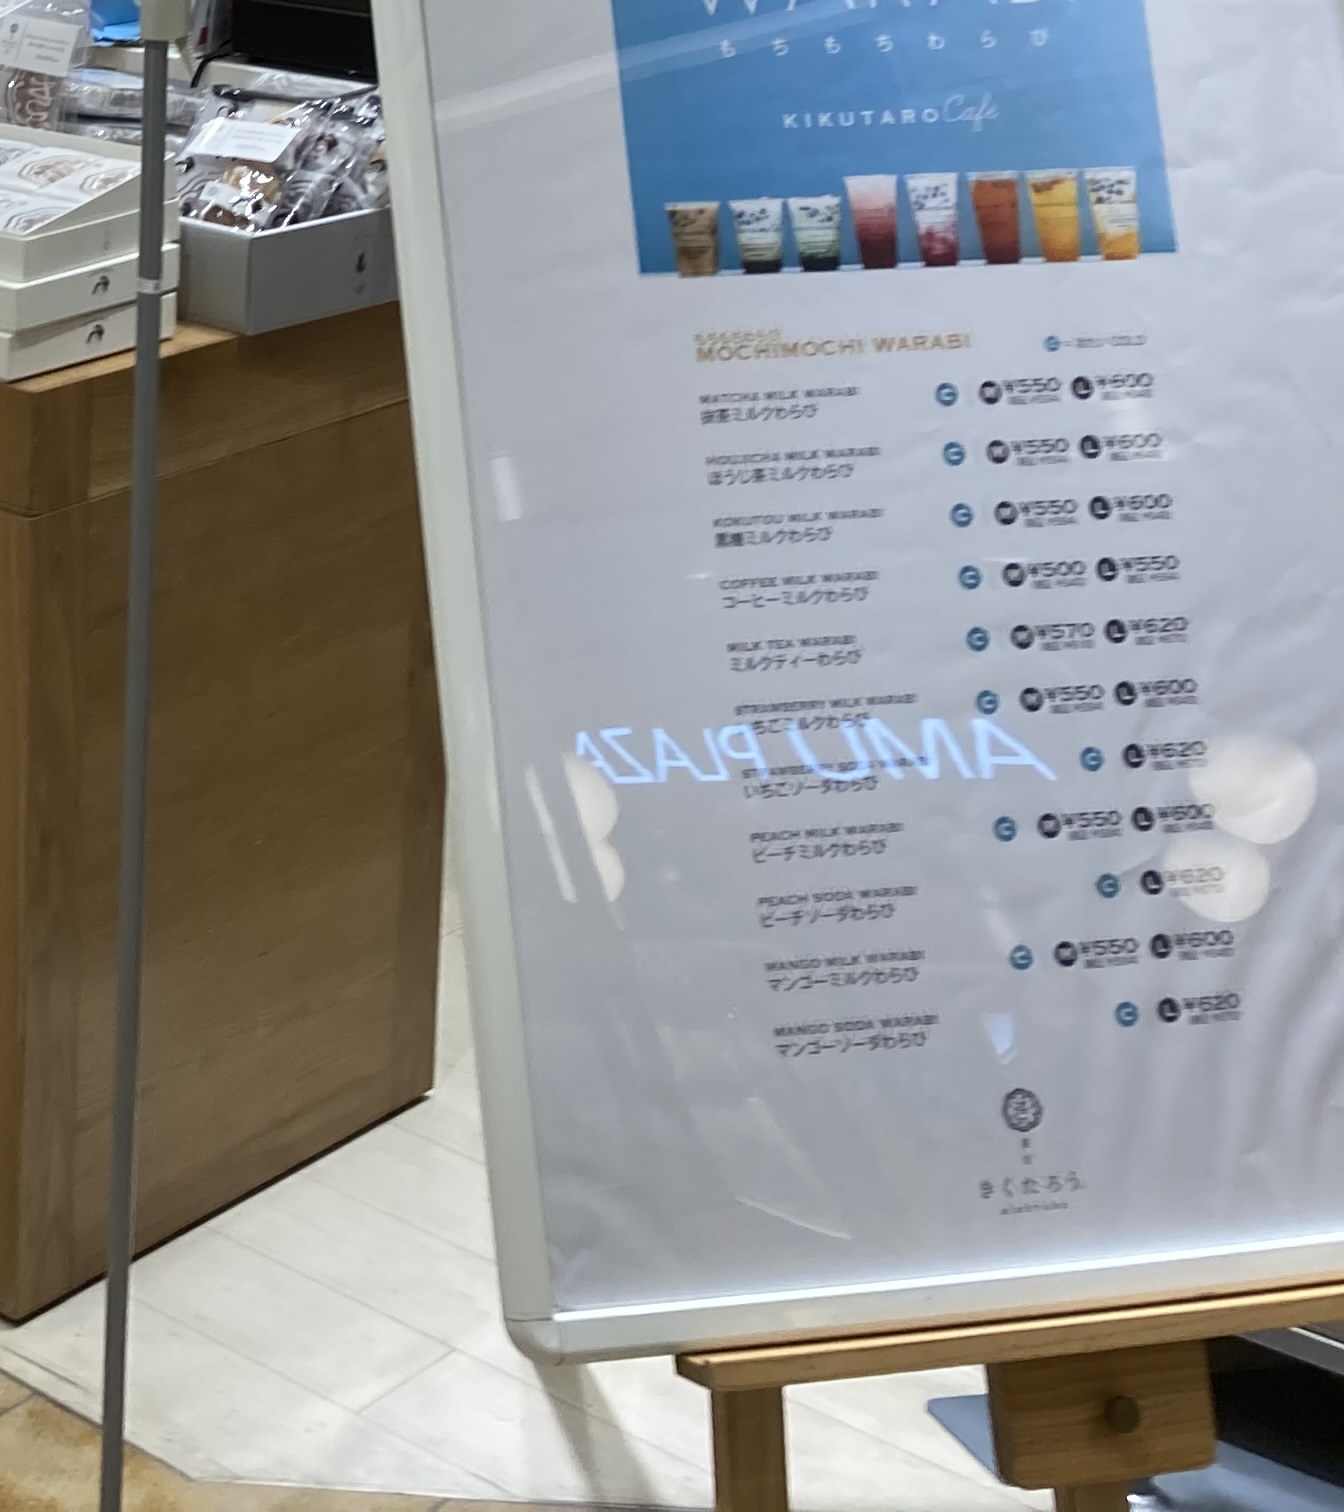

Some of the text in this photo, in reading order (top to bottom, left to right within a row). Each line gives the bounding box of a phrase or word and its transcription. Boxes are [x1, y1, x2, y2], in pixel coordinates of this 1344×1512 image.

[718, 25, 1051, 58] もちもちわらび
[781, 108, 941, 131] KIKUTARO
[695, 332, 973, 363] MOCHIMOCHI WARABI
